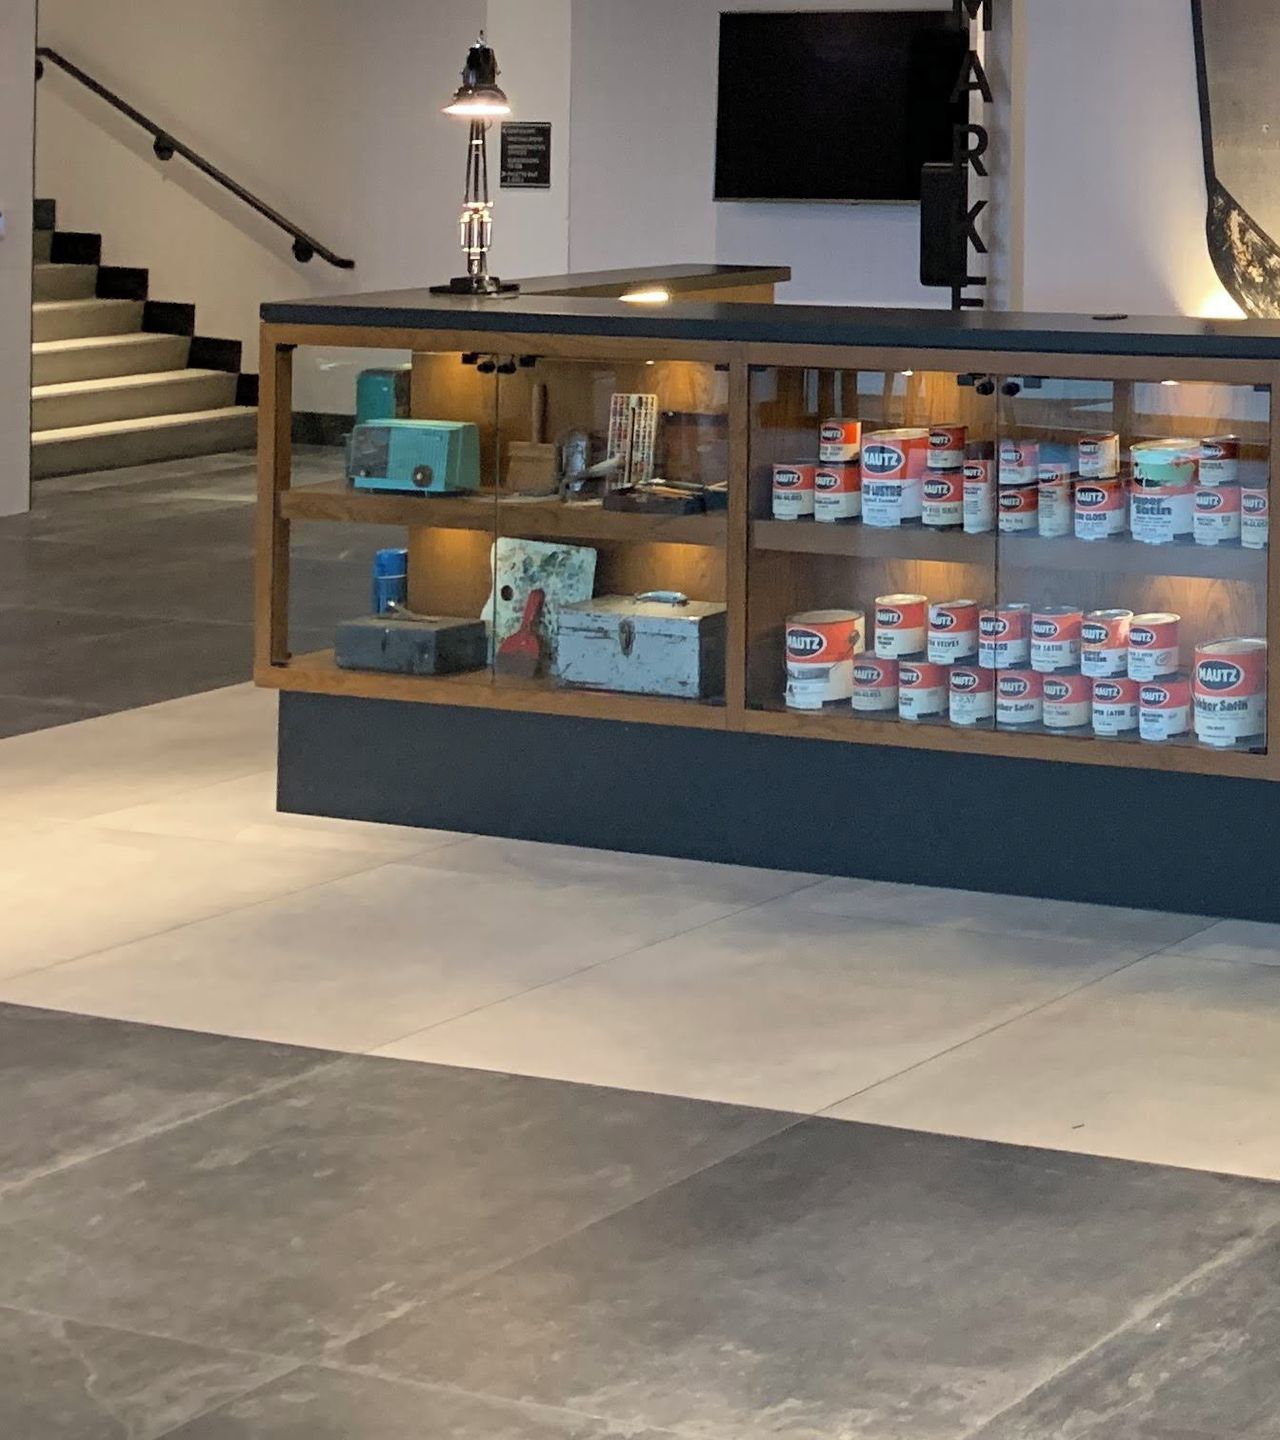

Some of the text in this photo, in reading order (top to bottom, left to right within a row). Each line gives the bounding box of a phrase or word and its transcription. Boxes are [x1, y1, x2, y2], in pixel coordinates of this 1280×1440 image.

[1135, 505, 1171, 516] Satin
[1200, 668, 1237, 681] MAUTZ
[1220, 700, 1248, 711] Satin
